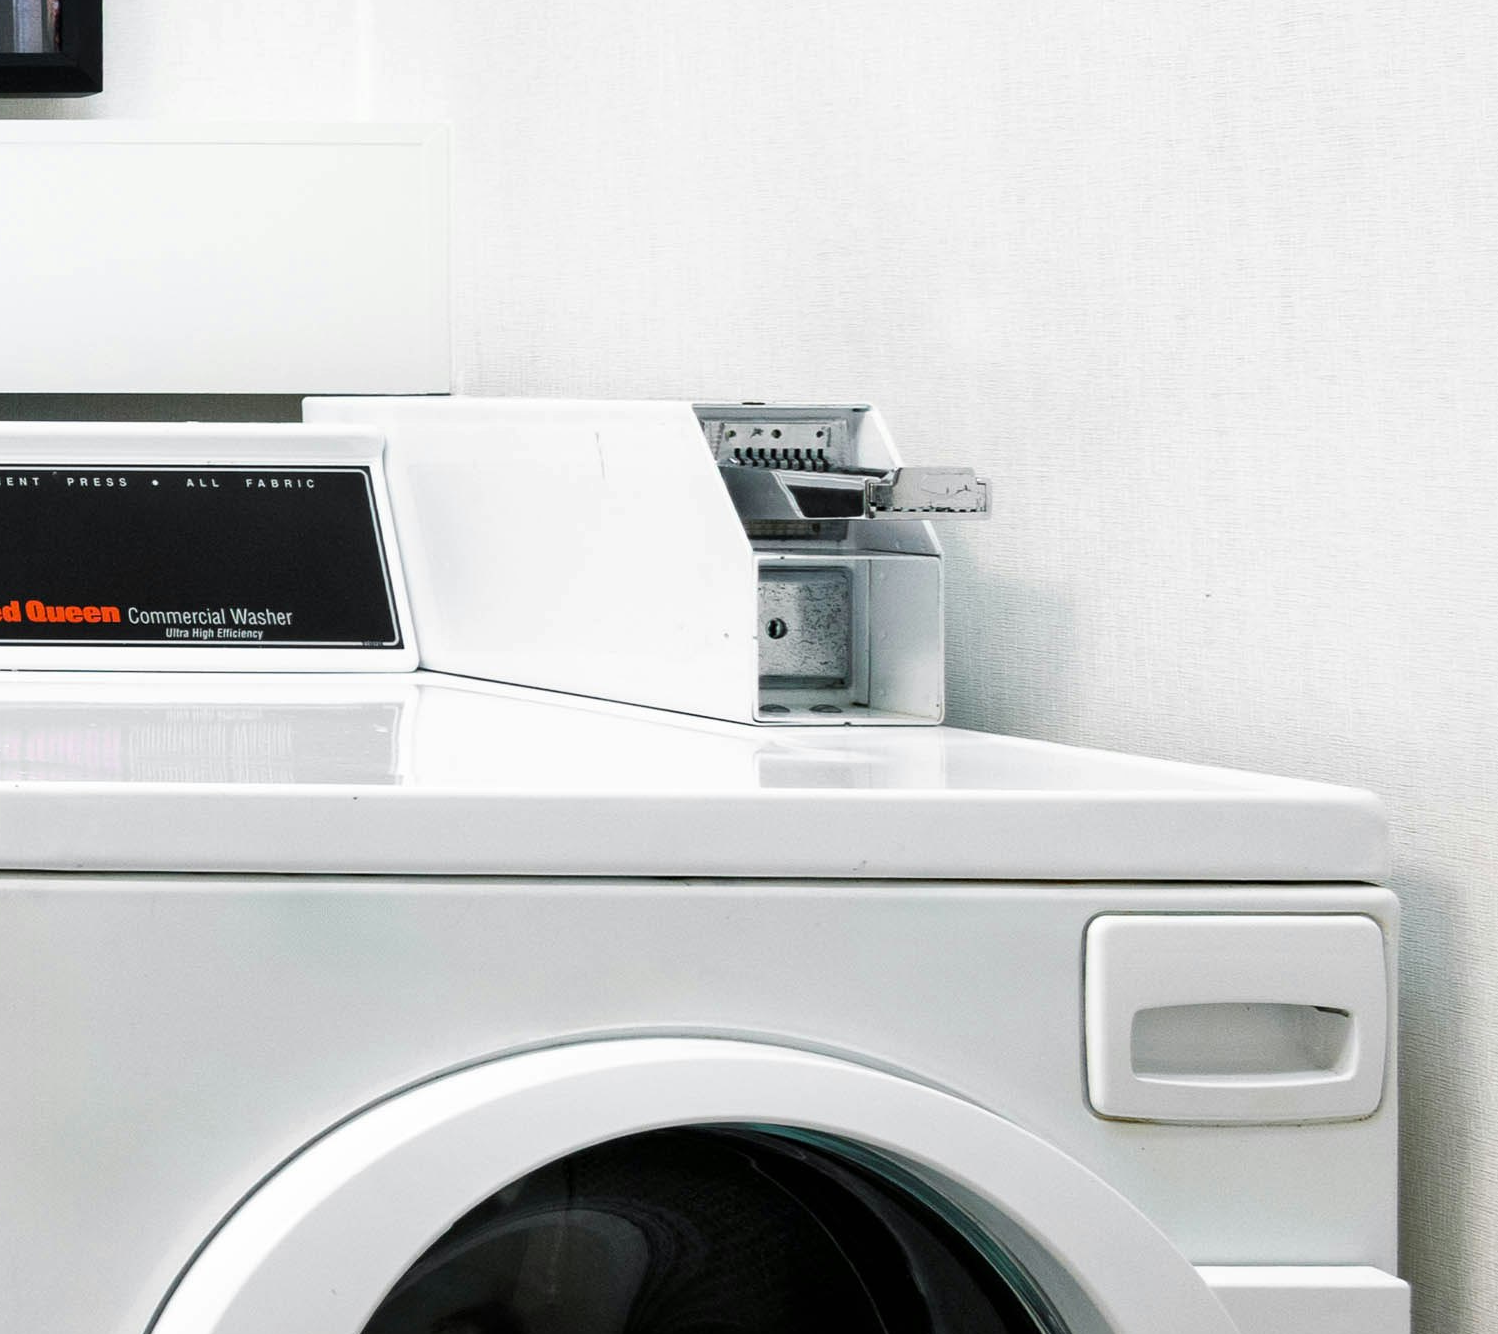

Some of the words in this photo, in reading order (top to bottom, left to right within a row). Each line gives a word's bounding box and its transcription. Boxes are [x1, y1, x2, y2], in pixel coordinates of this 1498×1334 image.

[67, 478, 128, 487] PRESS
[186, 479, 220, 488] ALL
[246, 479, 315, 488] FABRIC
[26, 600, 120, 623] Queen
[128, 607, 226, 626] Commercial
[230, 608, 292, 626] Washer
[166, 629, 189, 638] Ultra
[192, 629, 214, 640] High
[217, 629, 263, 640] Efficiency
